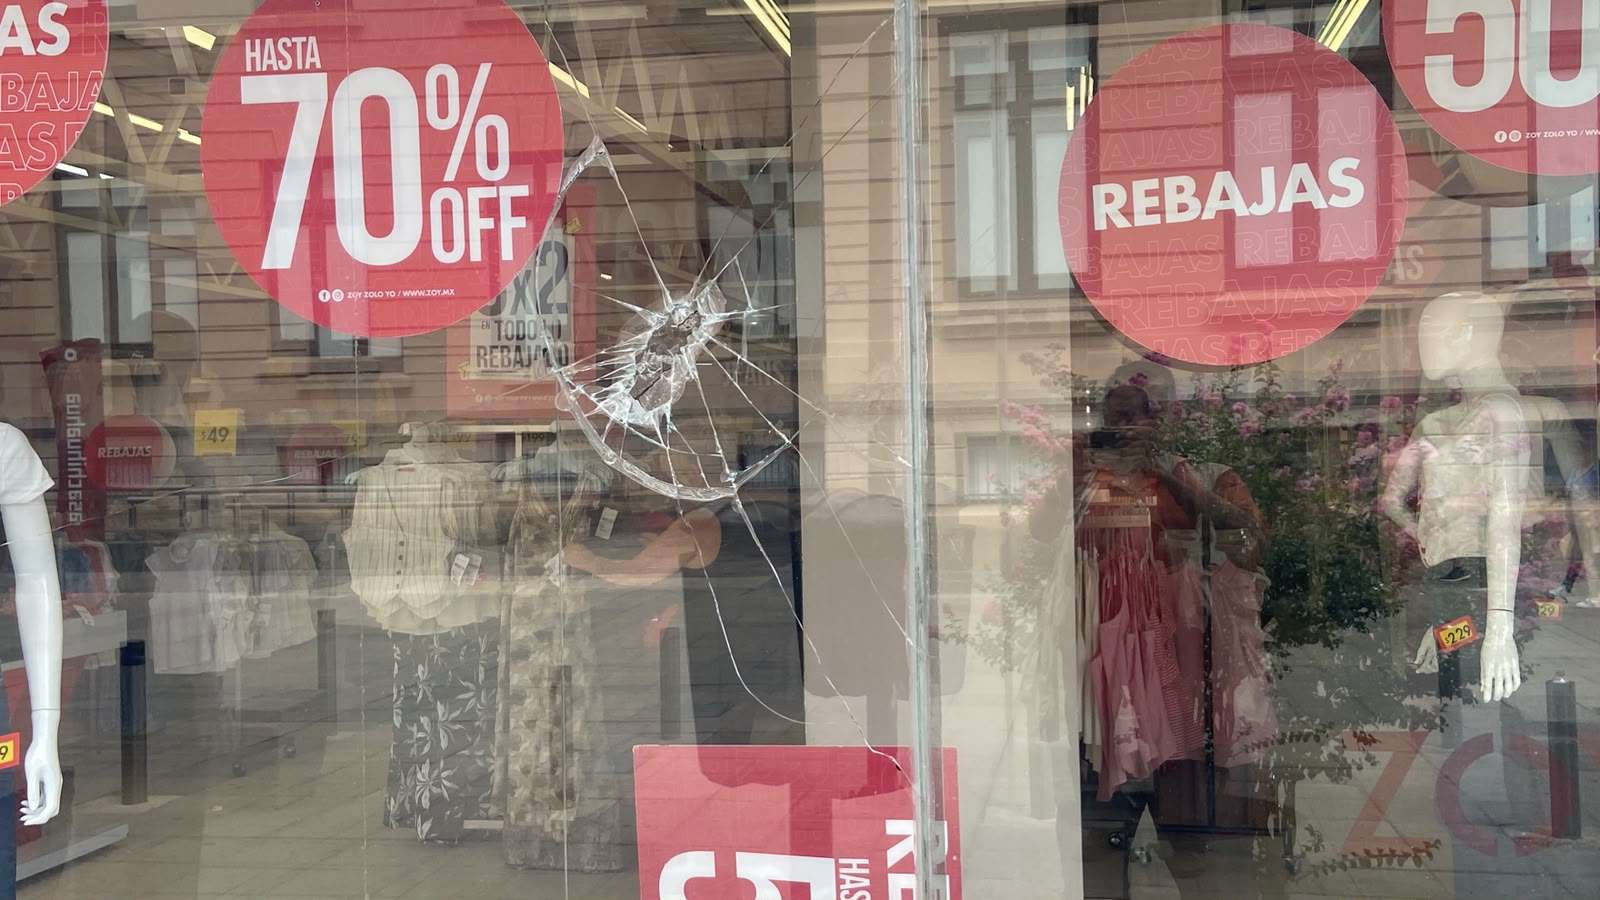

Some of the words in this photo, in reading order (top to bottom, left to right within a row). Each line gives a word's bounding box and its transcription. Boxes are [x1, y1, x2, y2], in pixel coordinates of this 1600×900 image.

[245, 36, 321, 72] HASTA
[1092, 157, 1365, 230] REBAJAS
[429, 184, 530, 264] OFF
[347, 291, 362, 299] ZOY
[494, 320, 537, 341] TODO
[98, 446, 152, 458] REBAJAS
[1444, 623, 1472, 646] $229
